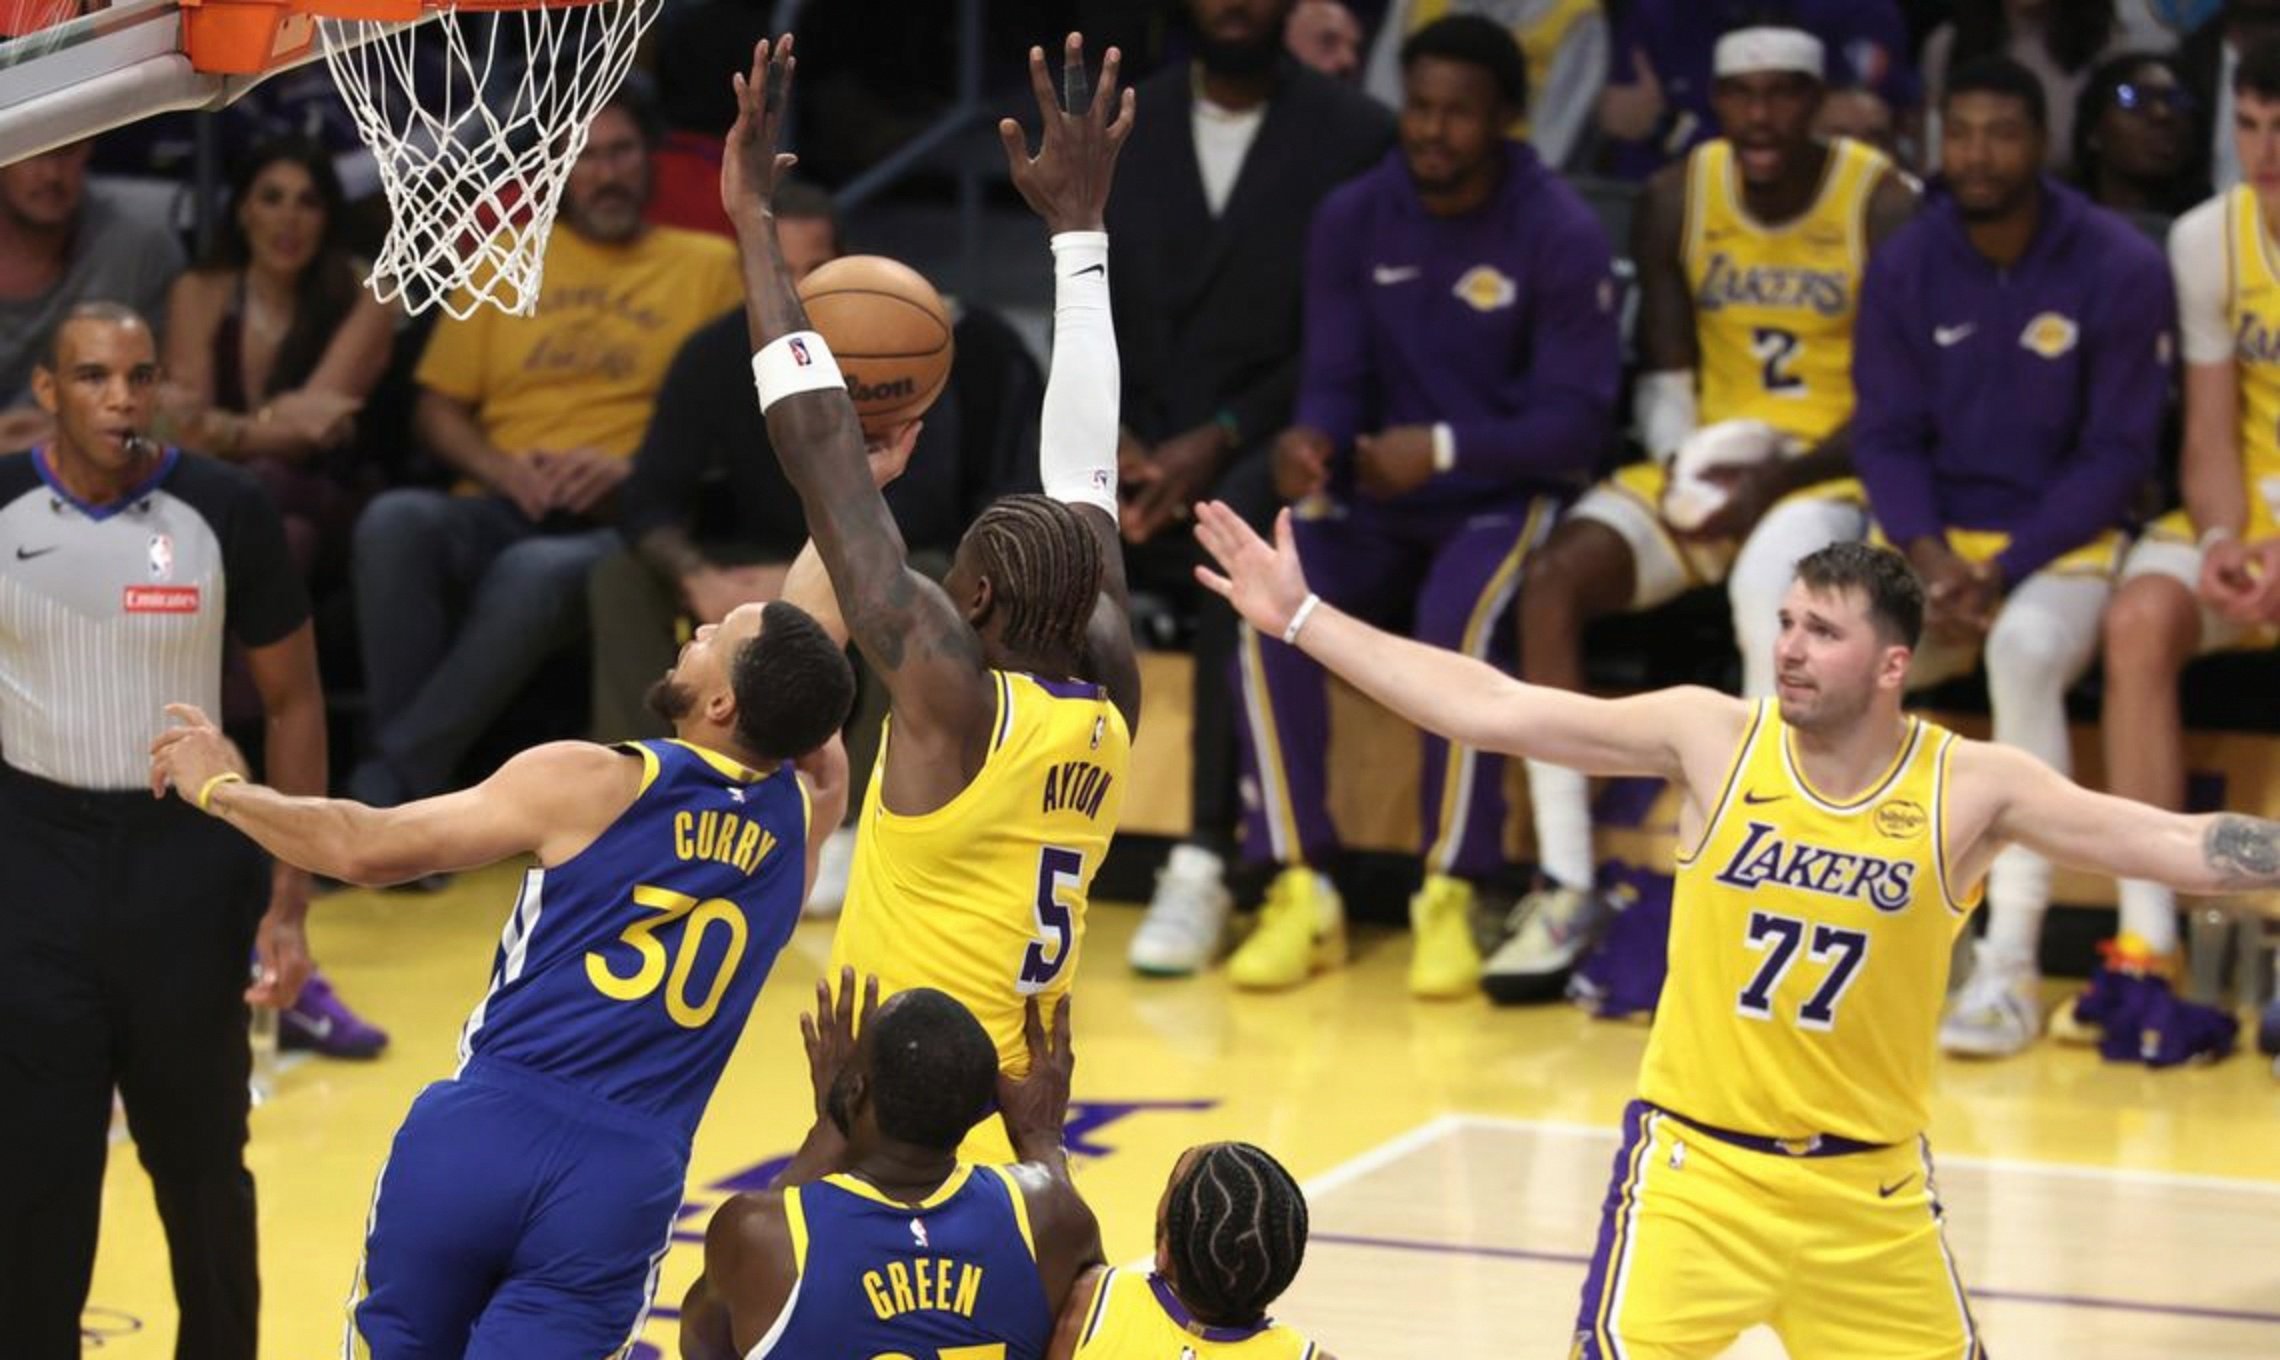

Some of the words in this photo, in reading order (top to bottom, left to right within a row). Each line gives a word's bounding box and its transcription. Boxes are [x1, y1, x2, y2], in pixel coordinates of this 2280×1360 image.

[844, 374, 916, 402] lson
[1751, 325, 1808, 398] 2
[127, 589, 197, 609] Emirates
[1042, 761, 1113, 821] AYTON
[673, 809, 778, 877] CURRY
[1714, 820, 1917, 914] LAKERS
[1015, 845, 1084, 992] 5
[584, 883, 749, 1029] 30
[1737, 911, 1869, 1033] 77
[862, 1256, 984, 1321] GREEN
